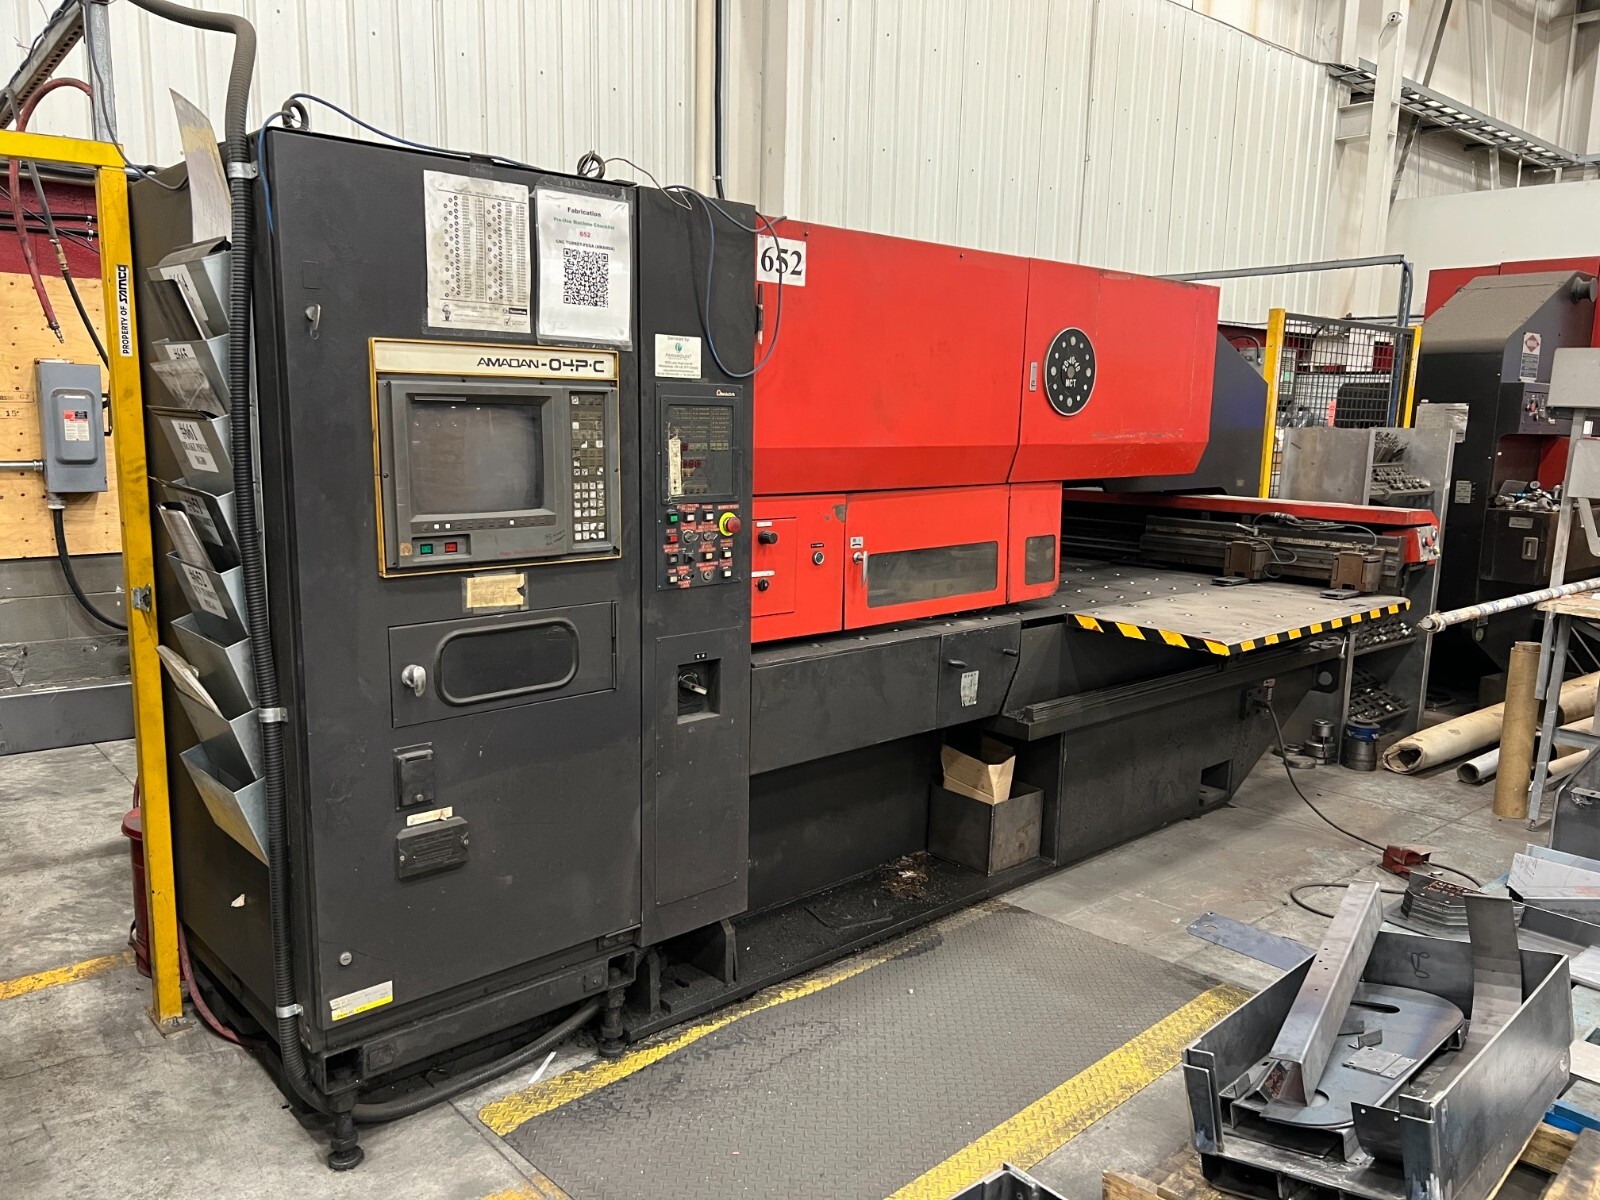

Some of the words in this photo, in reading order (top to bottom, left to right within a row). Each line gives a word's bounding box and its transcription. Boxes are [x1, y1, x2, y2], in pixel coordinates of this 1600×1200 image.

[567, 207, 602, 218] Fabrication
[553, 216, 572, 224] Pre-Use
[573, 219, 593, 227] Machine
[579, 231, 591, 239] 652
[761, 247, 803, 276] 652
[118, 265, 128, 304] SAMCO
[120, 305, 128, 316] OF
[121, 318, 130, 354] PROPERTY
[178, 422, 198, 441] #661
